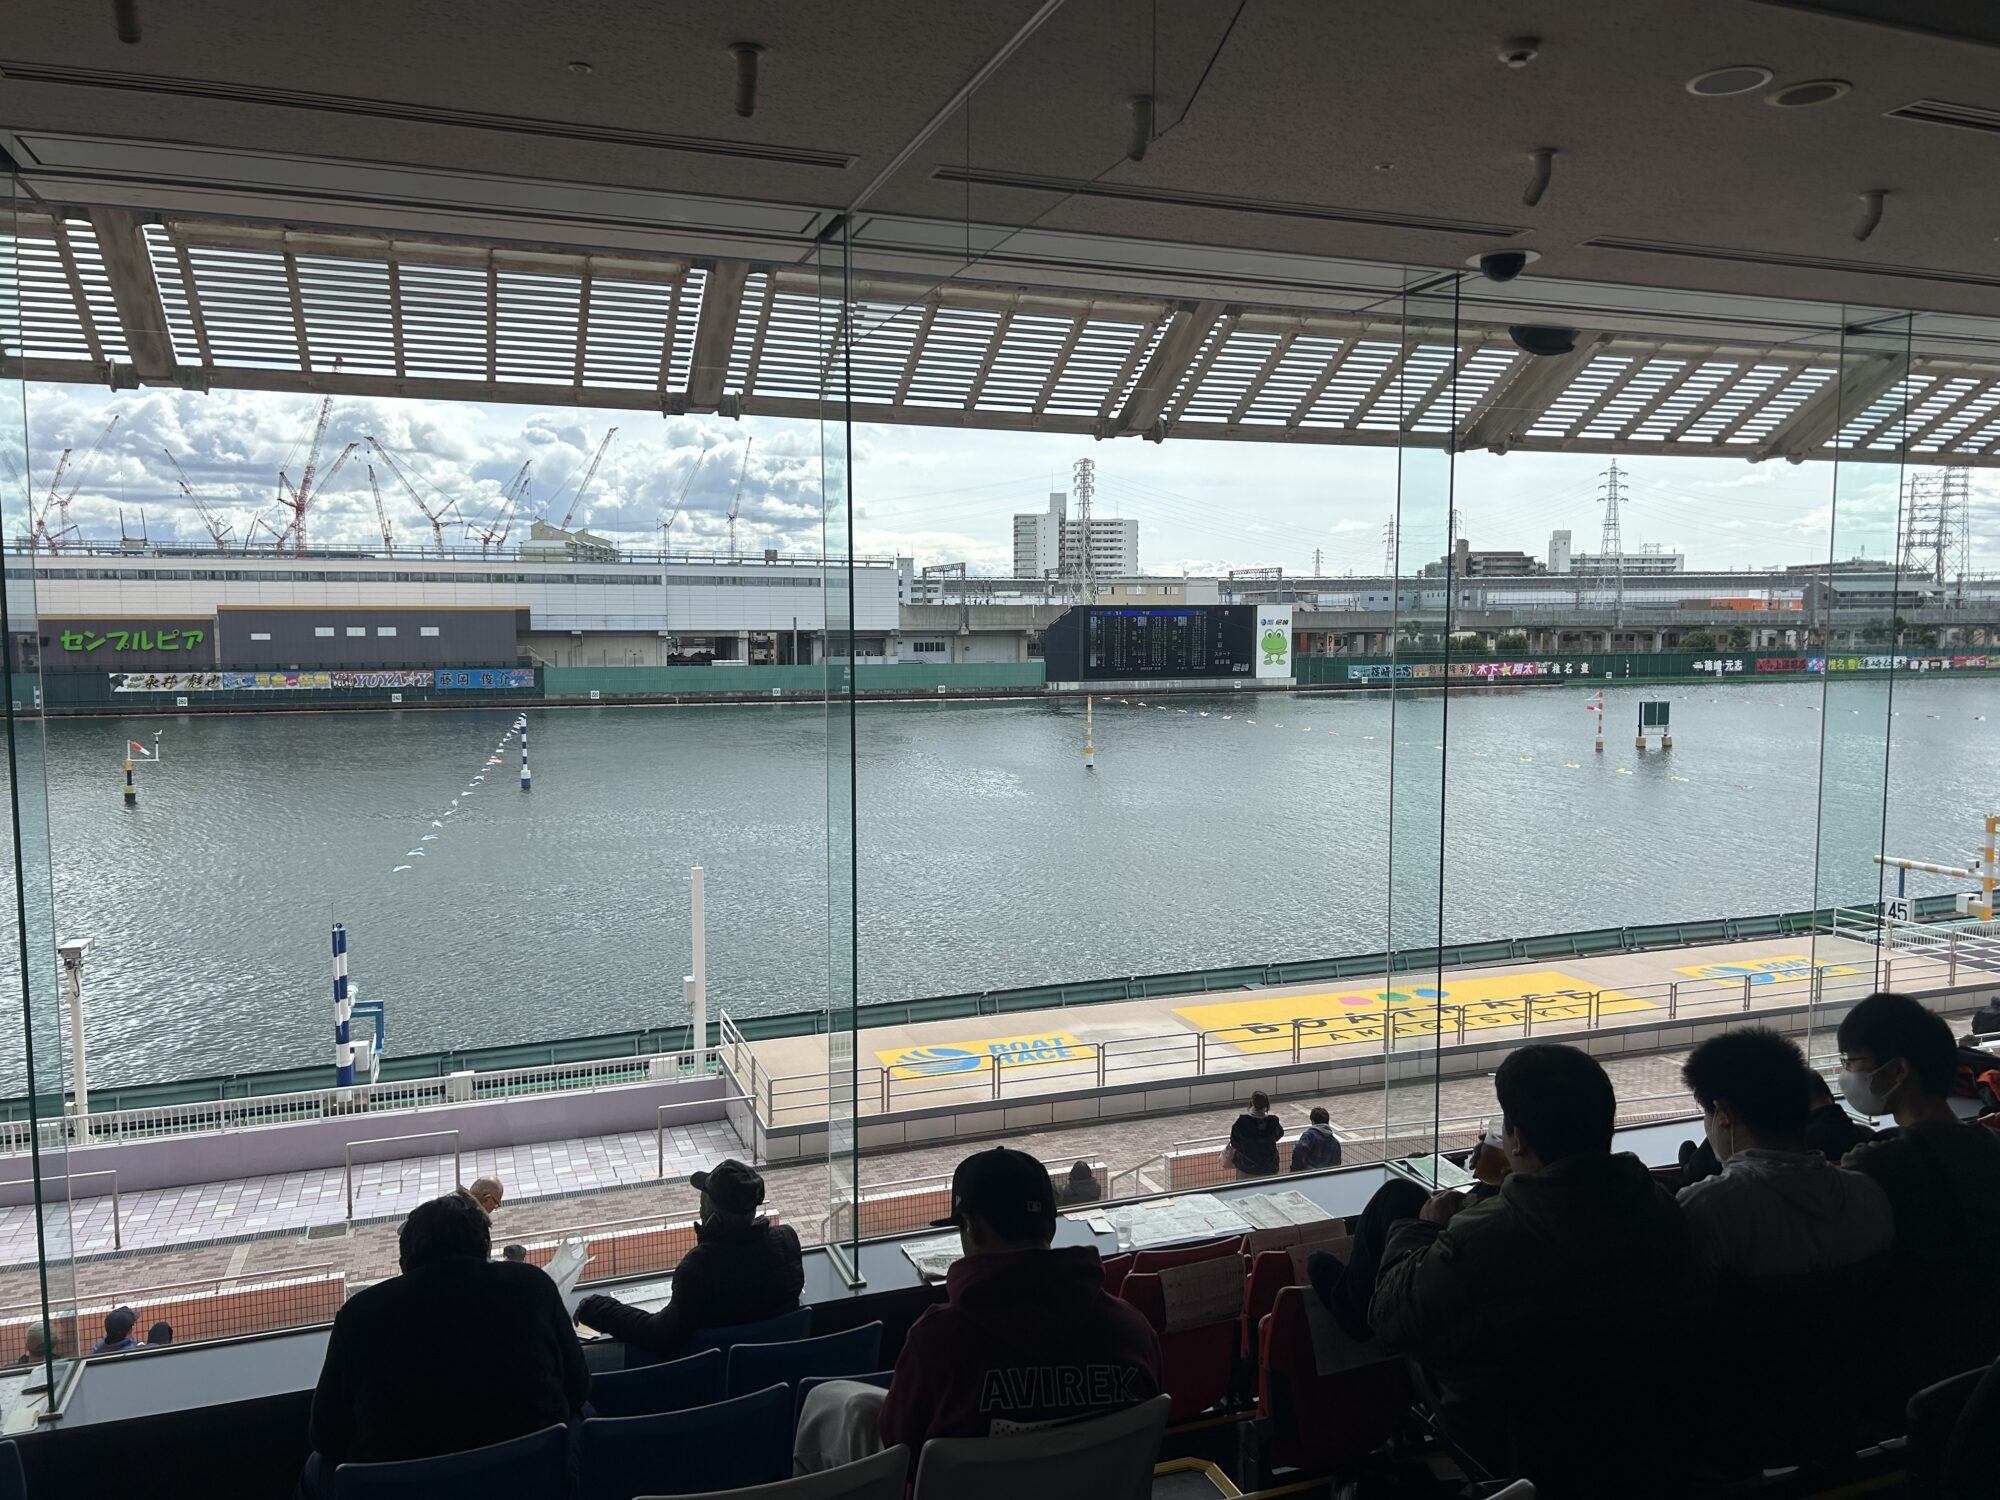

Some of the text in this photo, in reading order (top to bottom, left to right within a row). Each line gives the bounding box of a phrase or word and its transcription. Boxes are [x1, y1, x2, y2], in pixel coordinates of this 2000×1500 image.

[60, 629, 204, 650] センプルピア
[1477, 663, 1499, 675] 木下
[1887, 901, 1907, 921] 45
[988, 1037, 1065, 1055] BOAT
[979, 1364, 1139, 1412] AVIREX
